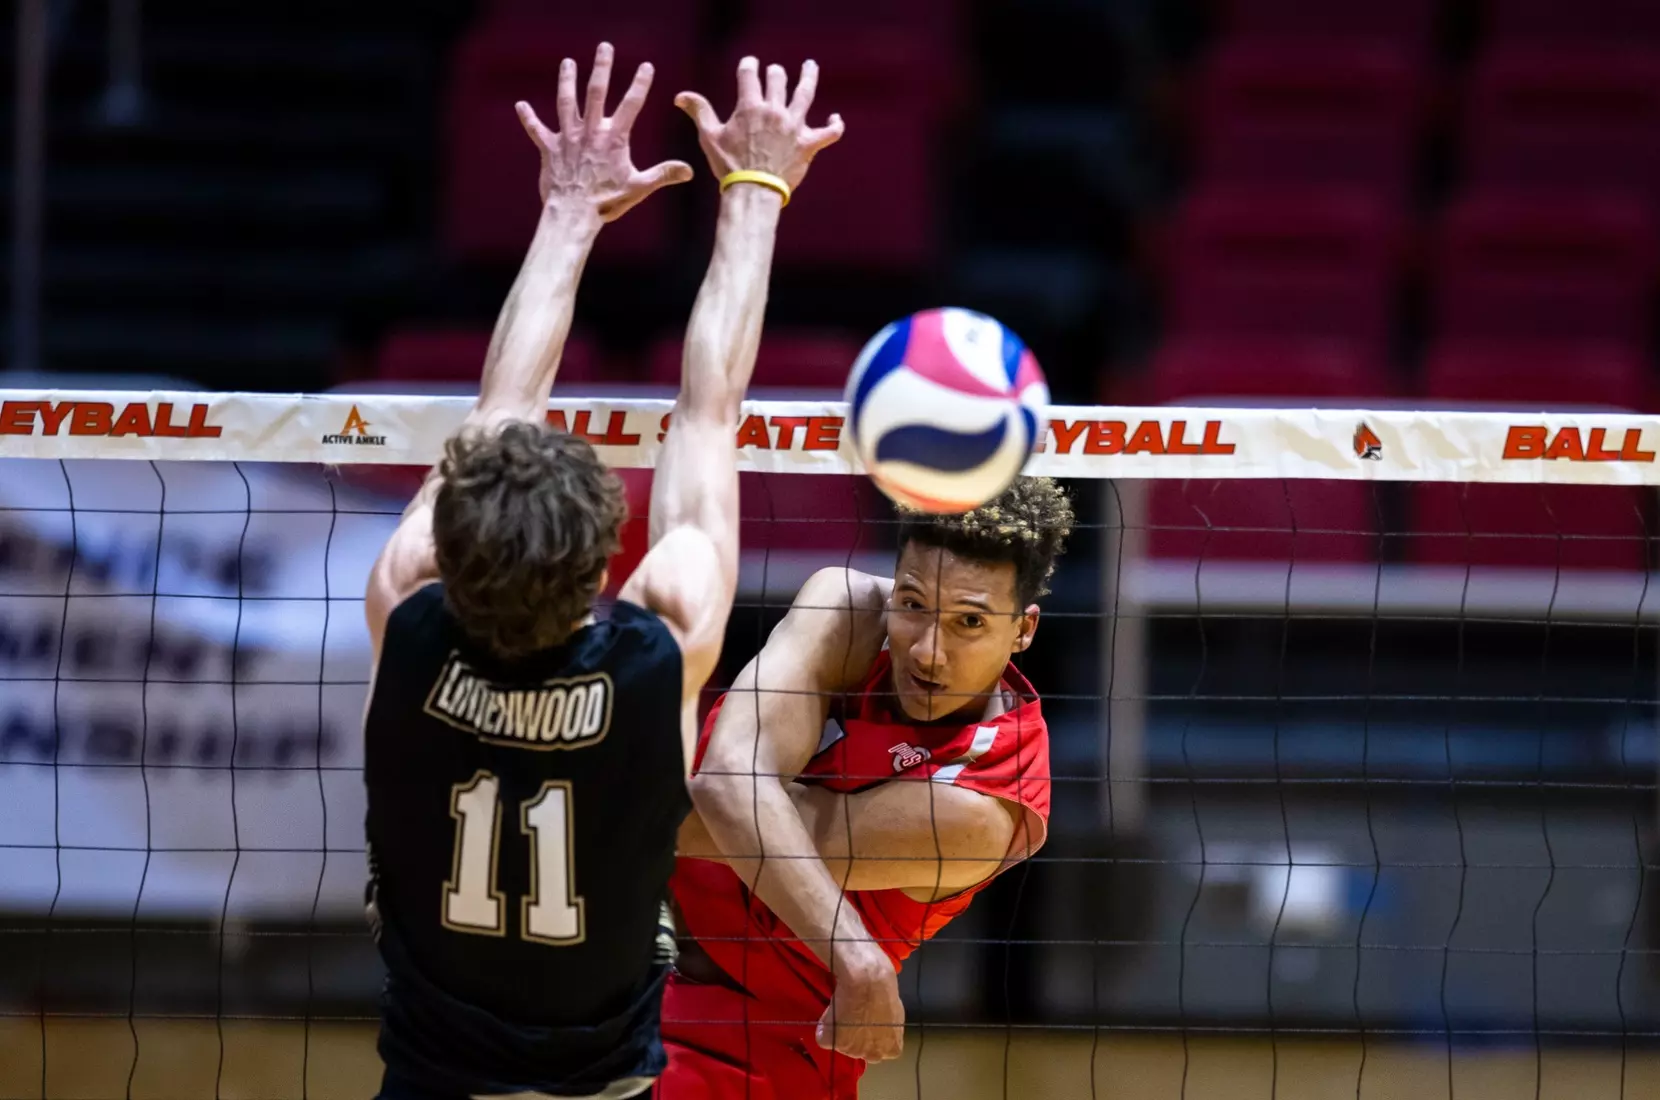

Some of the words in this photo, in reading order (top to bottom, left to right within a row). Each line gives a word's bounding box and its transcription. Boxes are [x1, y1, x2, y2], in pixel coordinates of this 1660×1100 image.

[322, 434, 354, 445] ACTIVE
[355, 435, 387, 446] ANKLE
[545, 409, 641, 445] ALL
[656, 412, 846, 451] ATE
[1033, 418, 1236, 455] YBALL
[1501, 425, 1657, 463] BALL
[442, 770, 585, 946] 11
